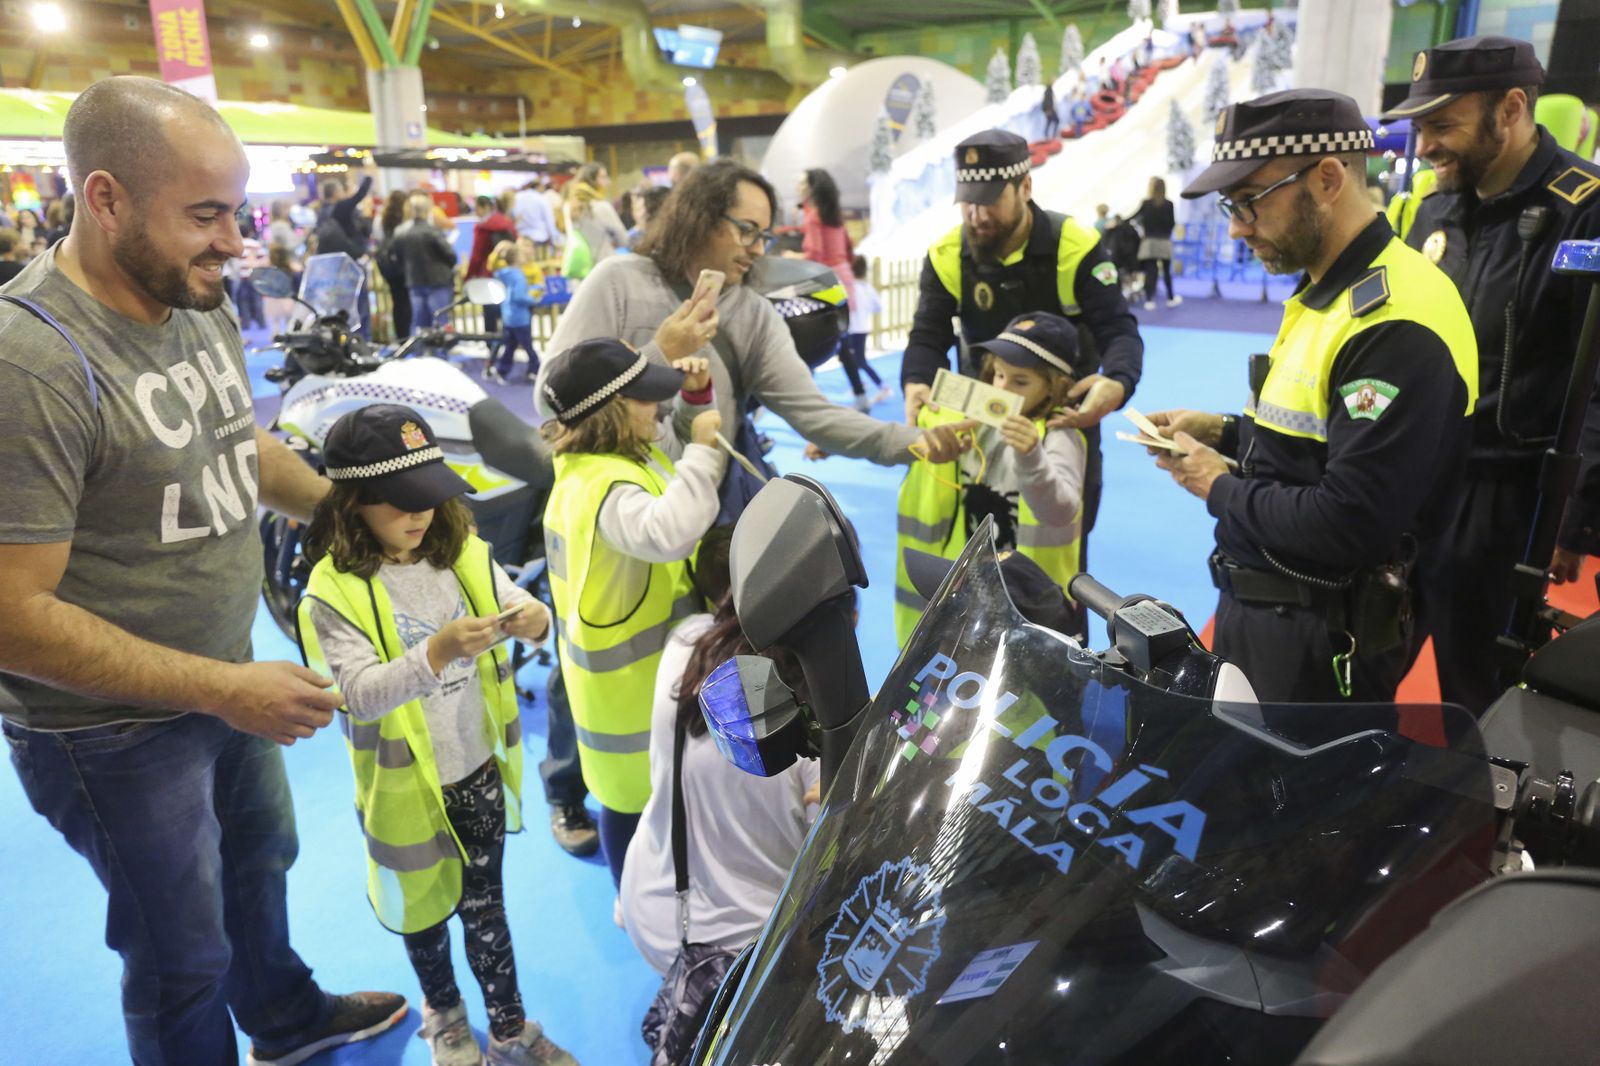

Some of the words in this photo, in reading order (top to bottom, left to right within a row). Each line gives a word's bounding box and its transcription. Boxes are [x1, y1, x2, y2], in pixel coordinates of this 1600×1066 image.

[159, 10, 183, 61] ZONA
[179, 7, 207, 67] PICNIC
[135, 342, 252, 449] CPH
[915, 652, 1206, 863] POLICÍA
[1002, 758, 1146, 870] LOCA
